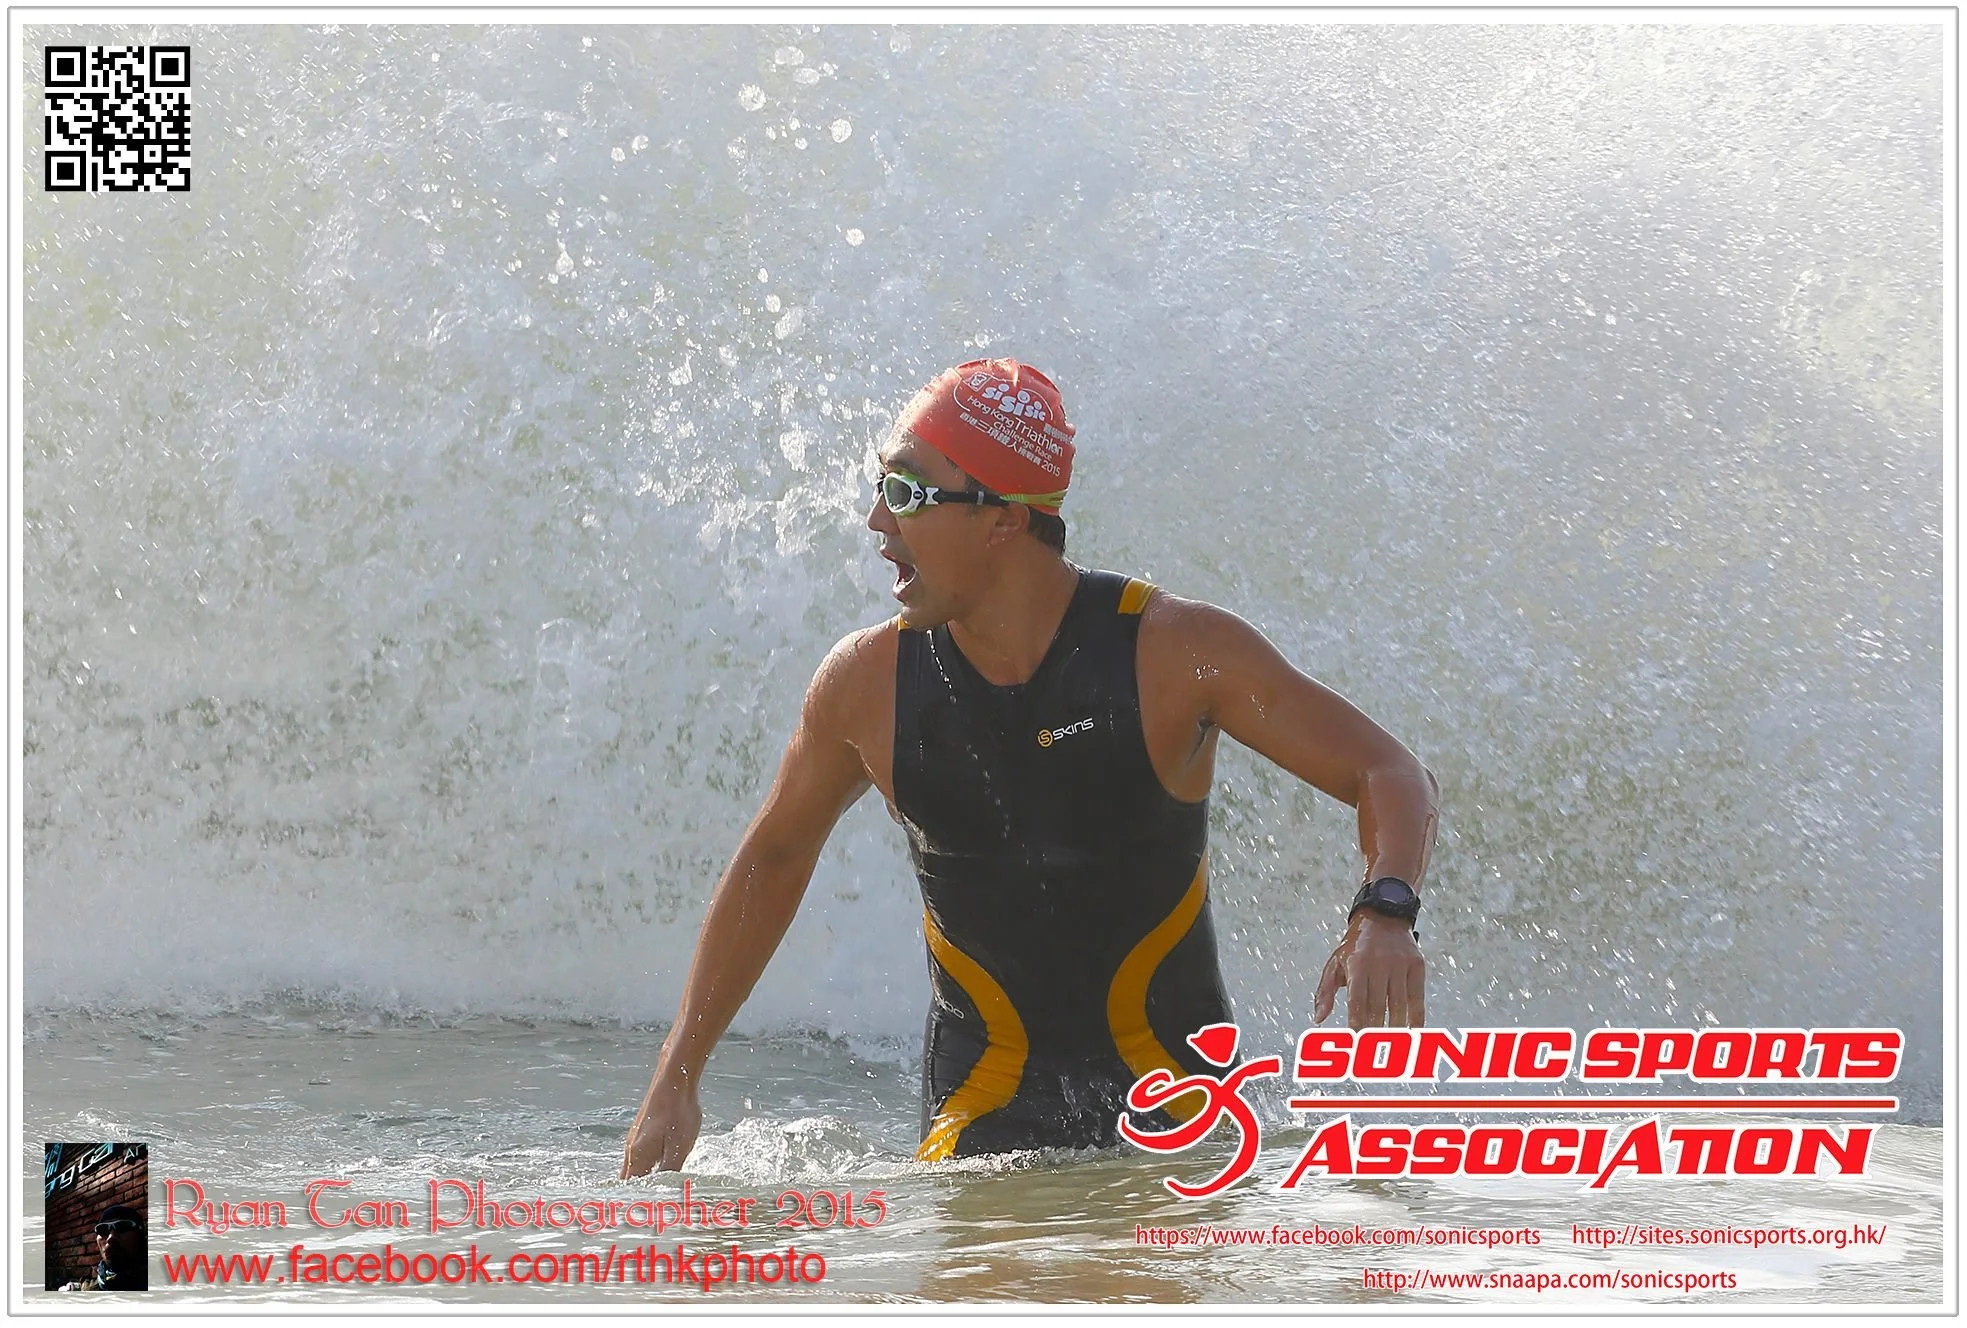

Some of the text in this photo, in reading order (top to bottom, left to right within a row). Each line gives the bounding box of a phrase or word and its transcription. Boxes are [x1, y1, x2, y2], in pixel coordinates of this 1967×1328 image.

[967, 396, 992, 414] Hong
[991, 409, 1014, 428] Kong
[1014, 417, 1063, 457] Triathlon
[993, 421, 1035, 450] Challenge
[1034, 446, 1052, 461] Race
[1041, 460, 1061, 477] 2015
